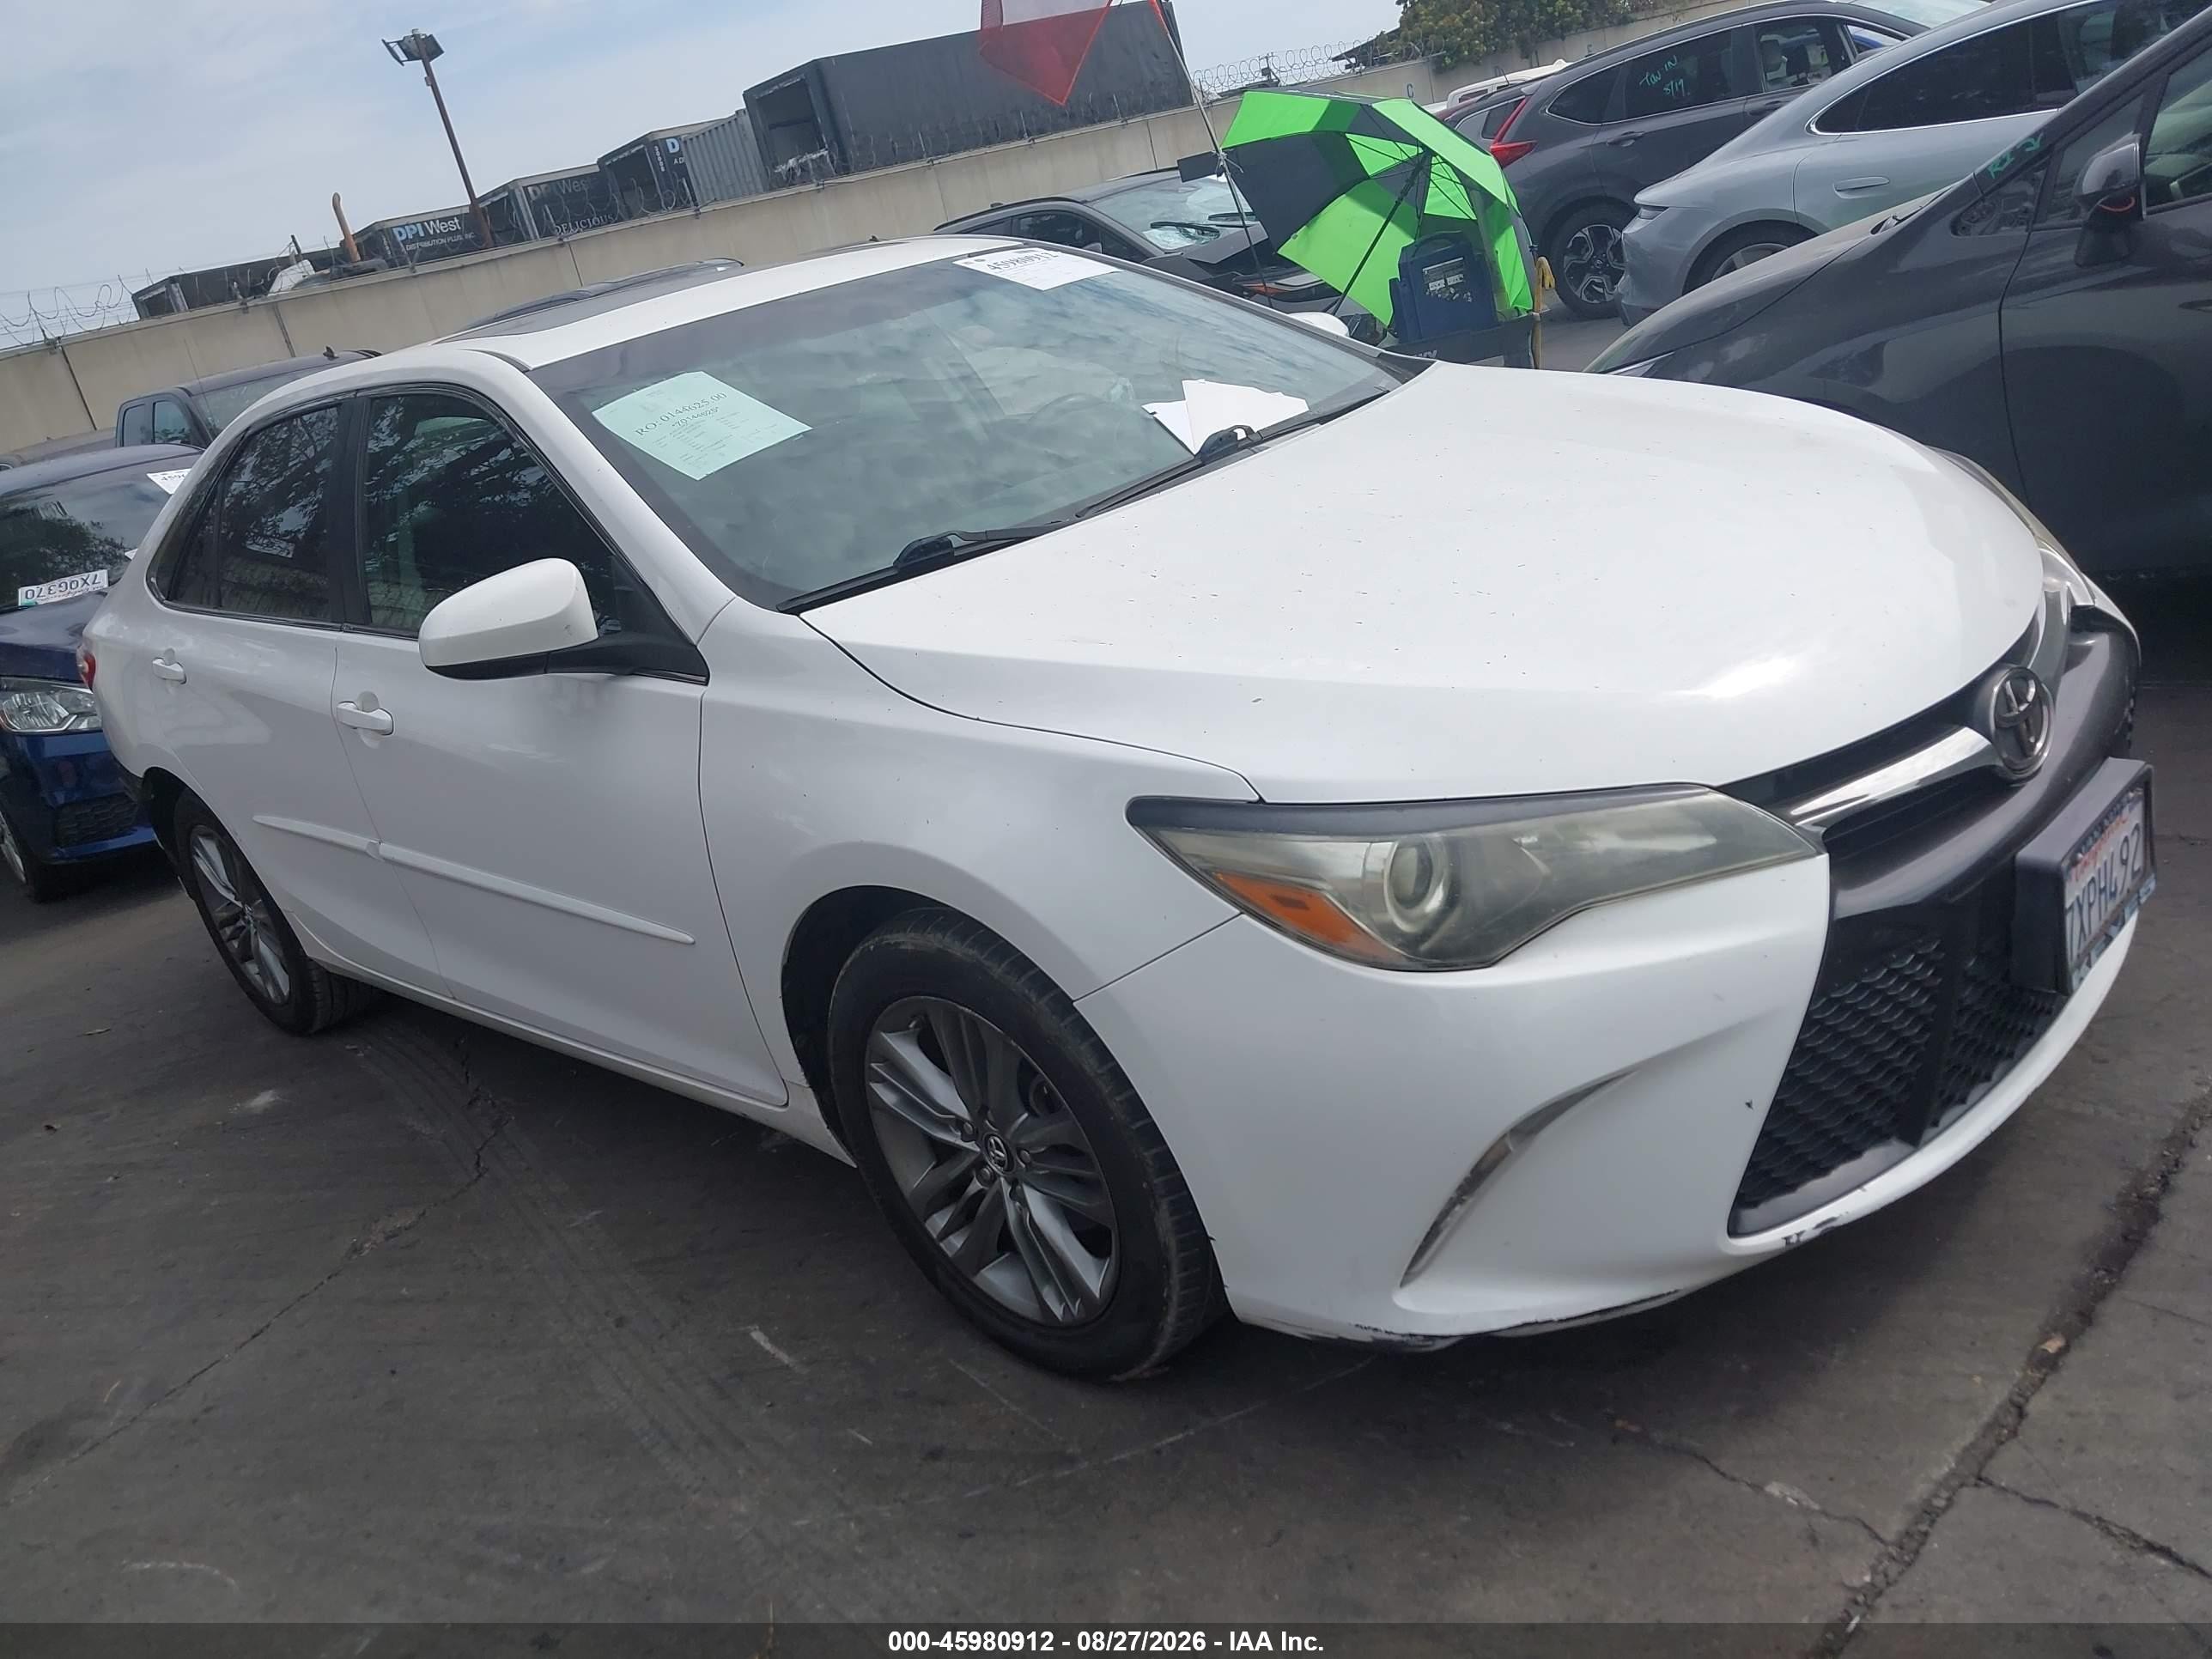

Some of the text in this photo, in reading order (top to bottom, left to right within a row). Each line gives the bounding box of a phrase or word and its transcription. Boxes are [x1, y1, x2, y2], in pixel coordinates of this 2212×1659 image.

[558, 178, 591, 194] Wes
[392, 216, 461, 241] DPI West
[2065, 822, 2143, 962] 7XPH492
